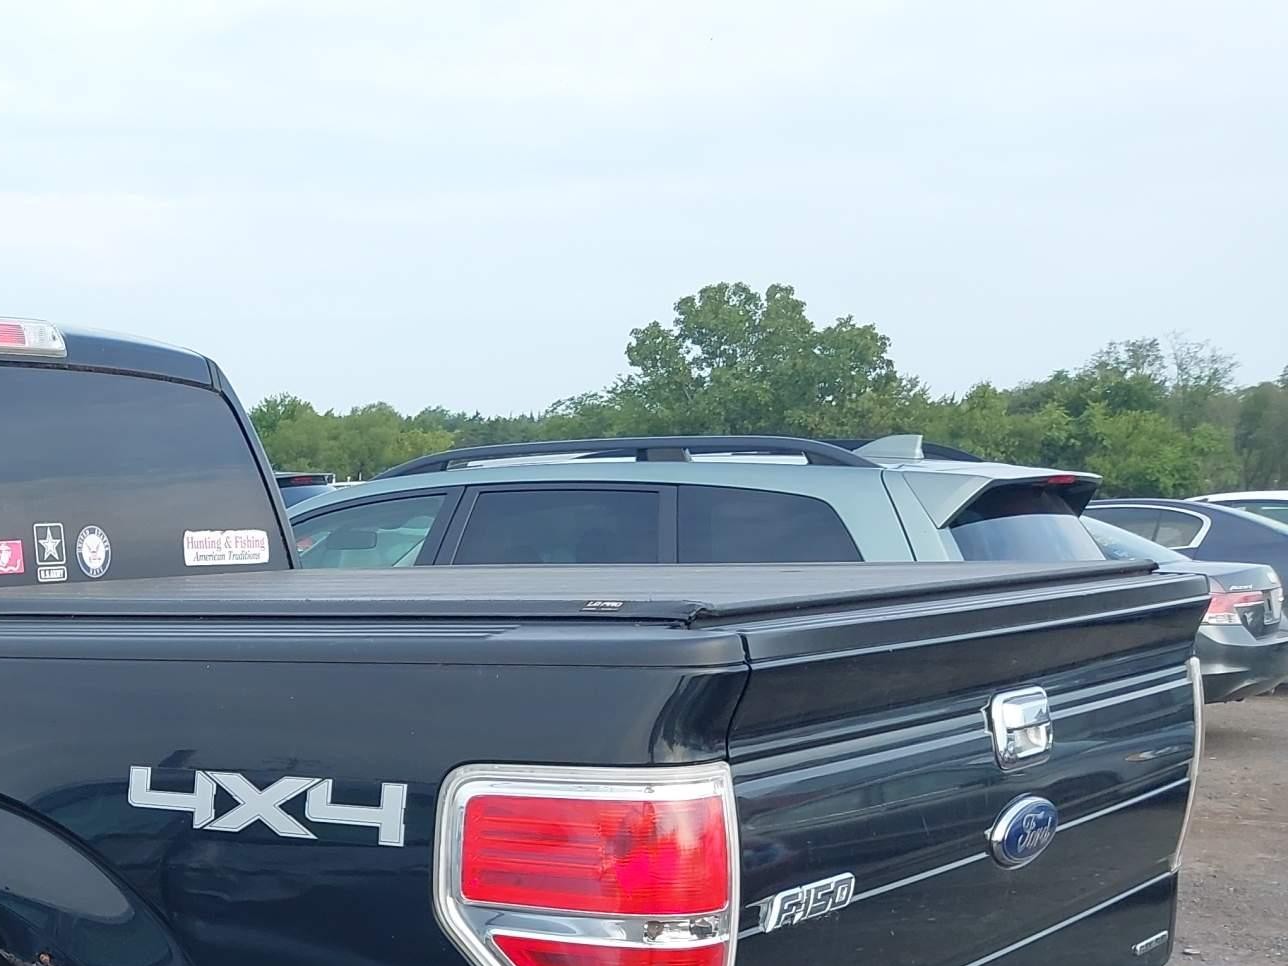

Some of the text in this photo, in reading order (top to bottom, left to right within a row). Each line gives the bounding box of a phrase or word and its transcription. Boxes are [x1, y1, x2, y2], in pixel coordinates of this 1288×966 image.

[186, 535, 265, 551] Hunting & Fishing
[193, 550, 261, 562] American Traditions
[1016, 810, 1053, 854] Ford
